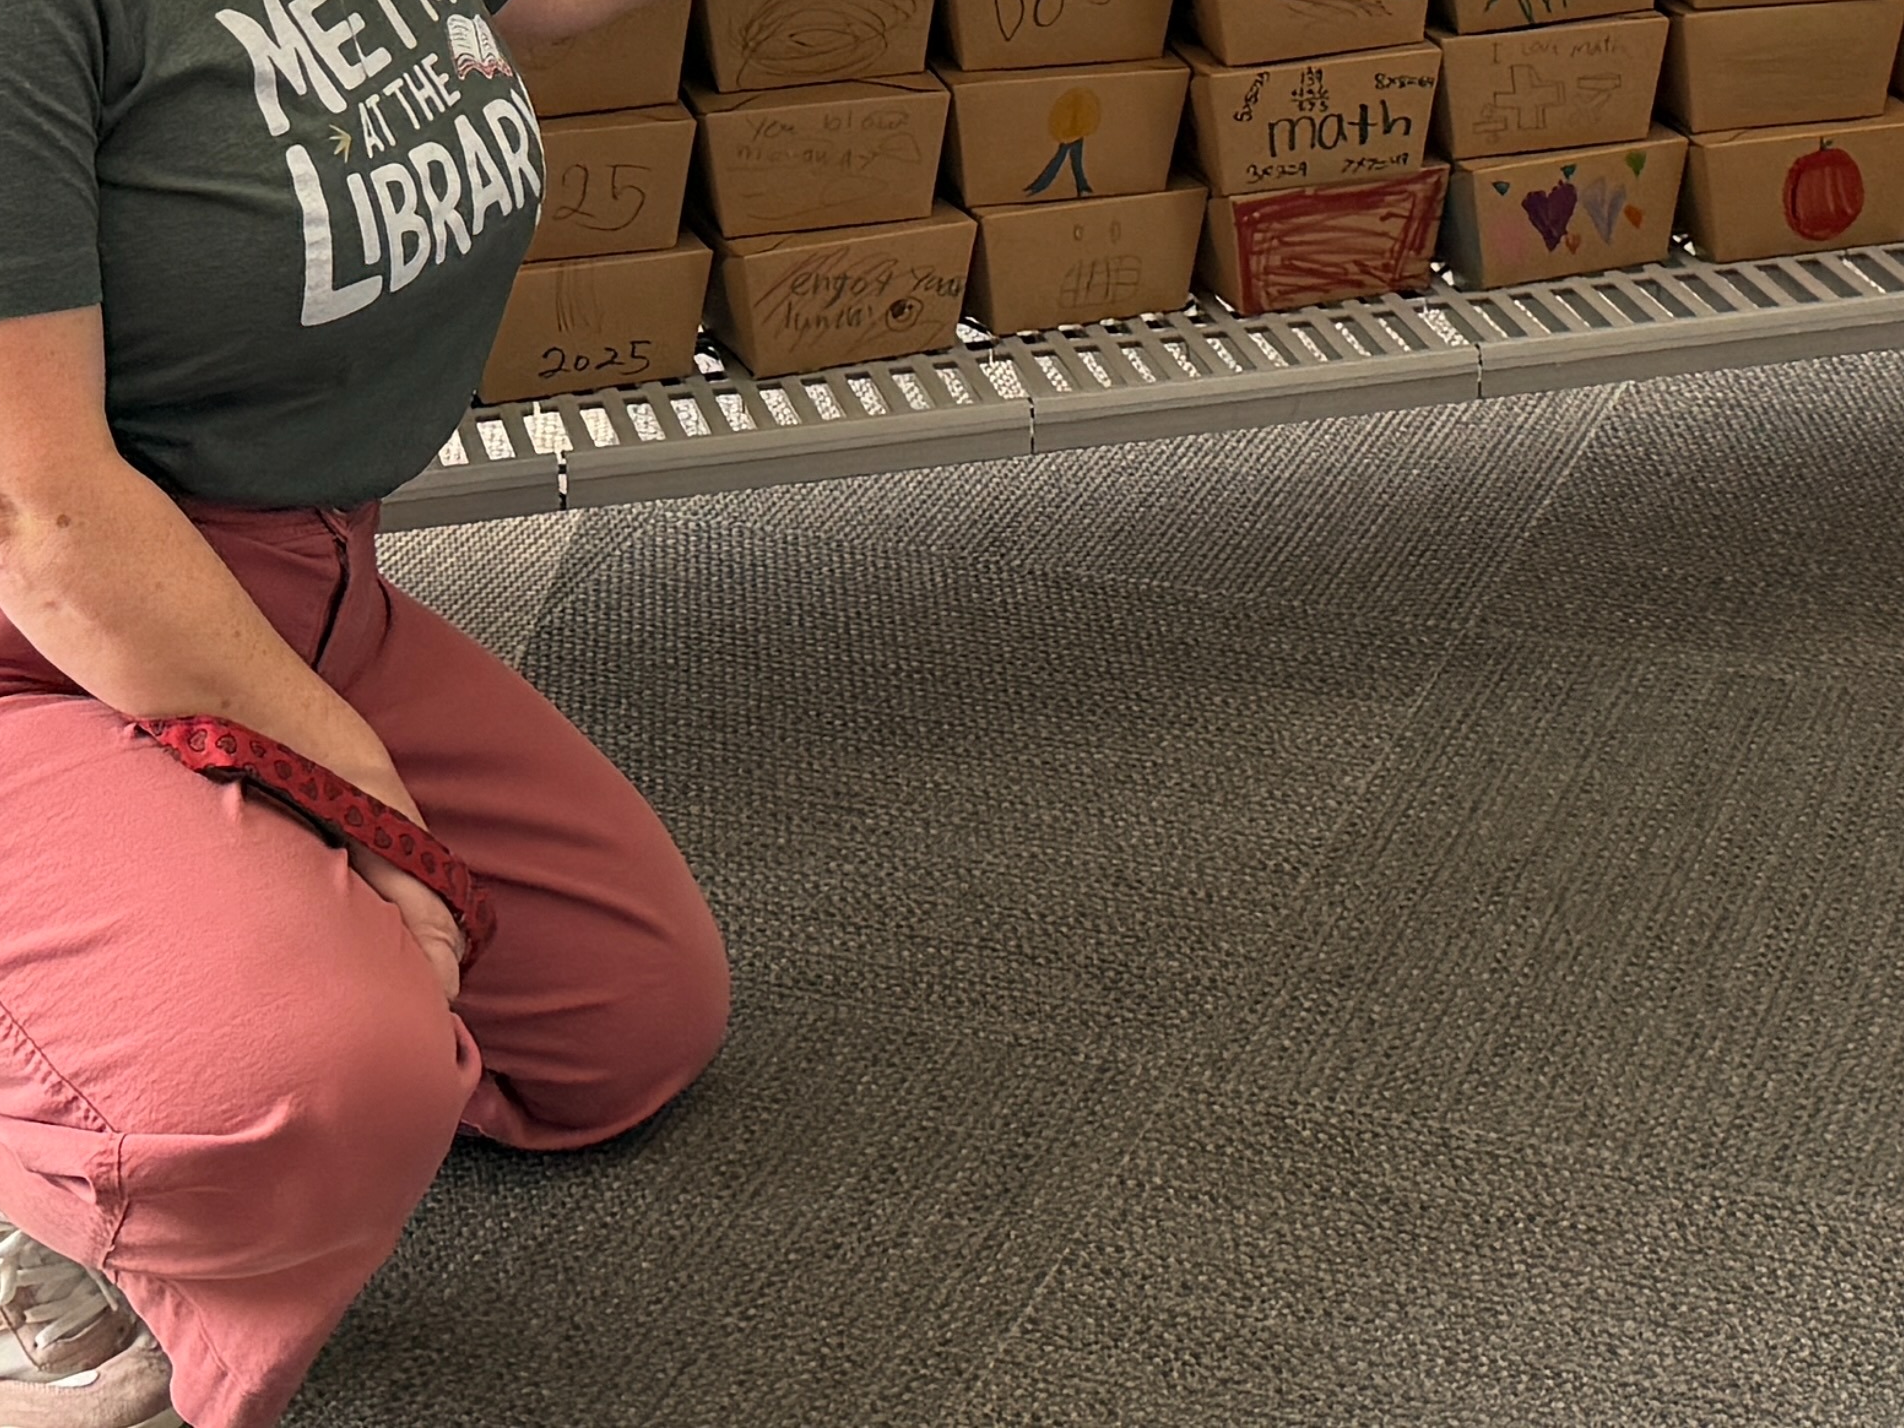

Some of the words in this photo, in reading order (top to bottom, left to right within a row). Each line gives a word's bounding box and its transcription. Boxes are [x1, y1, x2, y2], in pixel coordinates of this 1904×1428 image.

[358, 94, 397, 159] AT
[383, 52, 462, 131] THE
[1267, 98, 1413, 159] math
[538, 339, 653, 382] 2025
